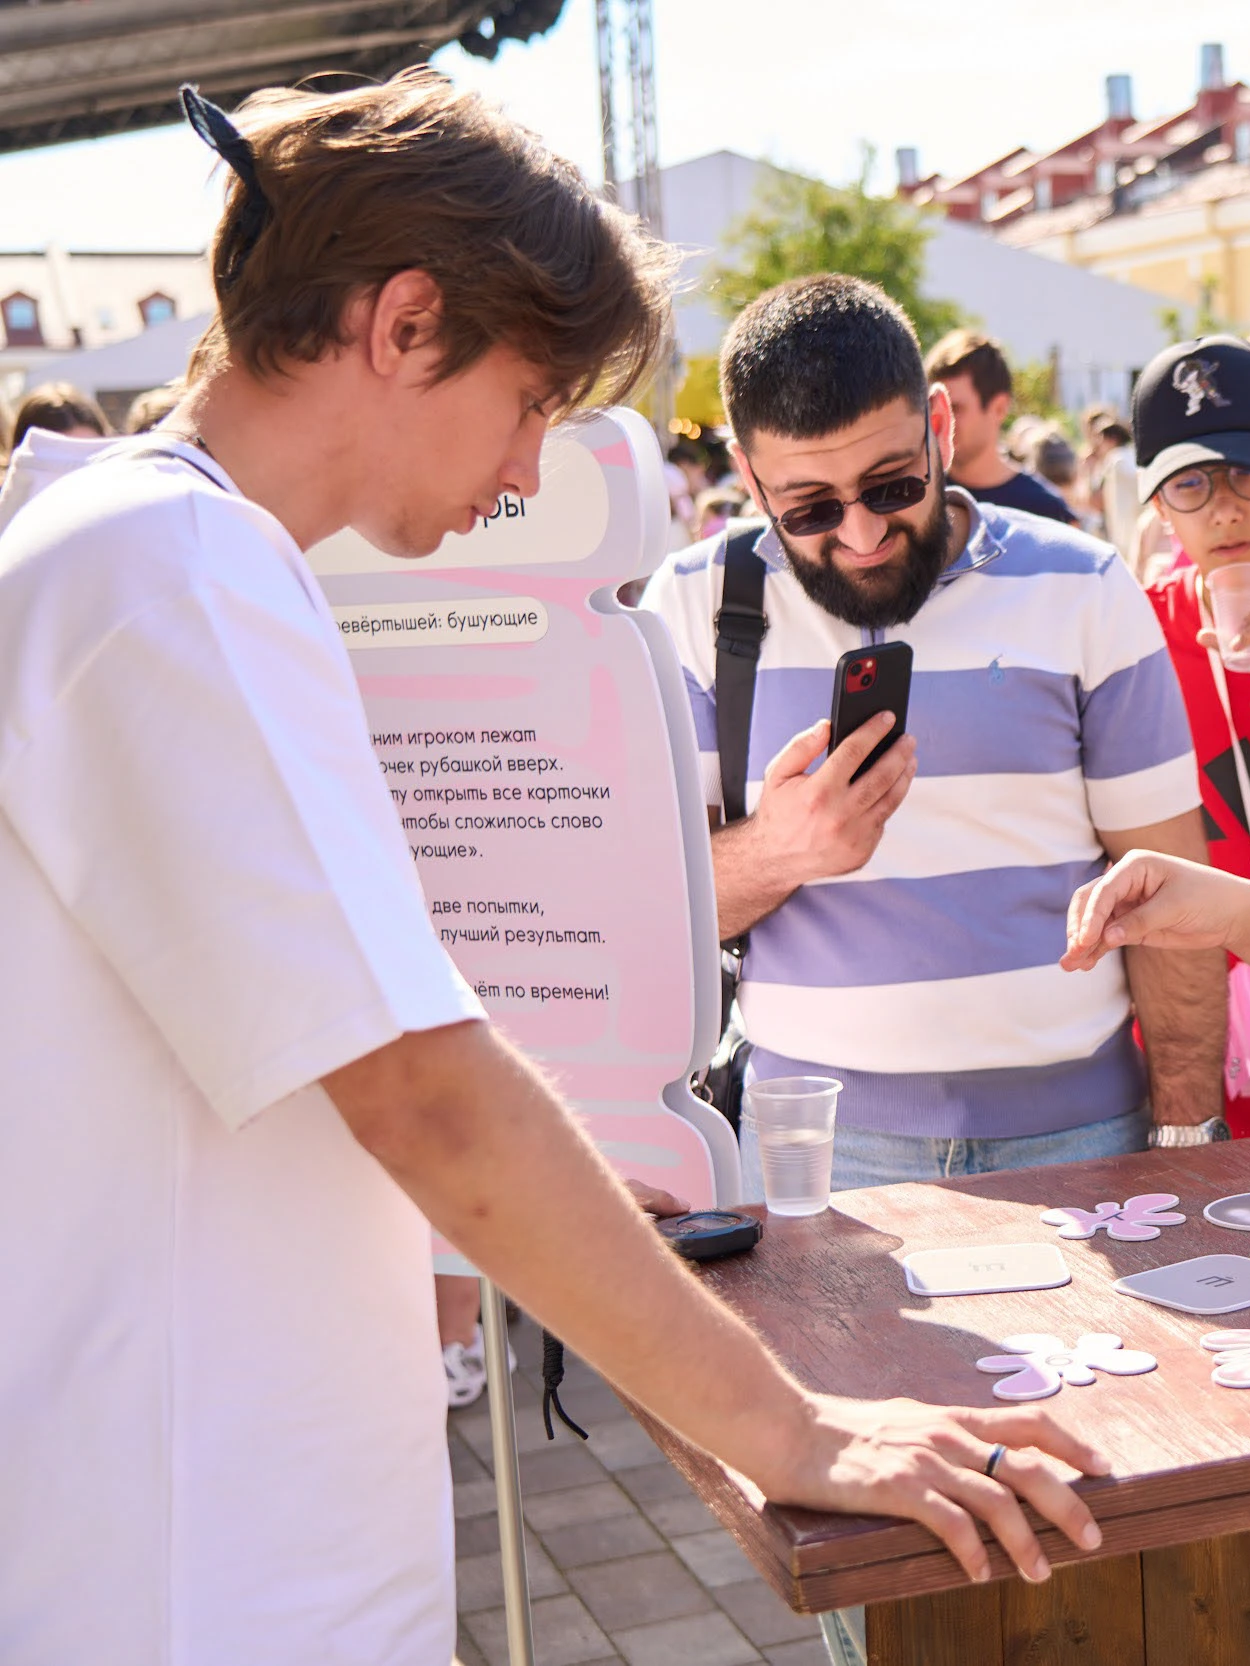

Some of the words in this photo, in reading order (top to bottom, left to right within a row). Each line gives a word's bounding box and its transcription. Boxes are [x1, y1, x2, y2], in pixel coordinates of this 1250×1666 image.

[447, 611, 538, 632] бушующие
[371, 732, 403, 745] ним
[407, 730, 476, 748] игроком
[480, 729, 536, 743] лежат
[420, 756, 502, 777] рубашкой
[508, 758, 564, 776] вверх.
[414, 788, 487, 804] открыть
[493, 787, 522, 800] все
[527, 785, 610, 804] карточки
[455, 815, 546, 829] сложилось
[551, 815, 603, 829] слово
[432, 900, 462, 915] две
[467, 901, 545, 917] попытки,
[441, 926, 500, 945] лучший
[505, 929, 606, 946] результат.
[505, 985, 526, 999] по
[532, 984, 609, 1002] времени!
